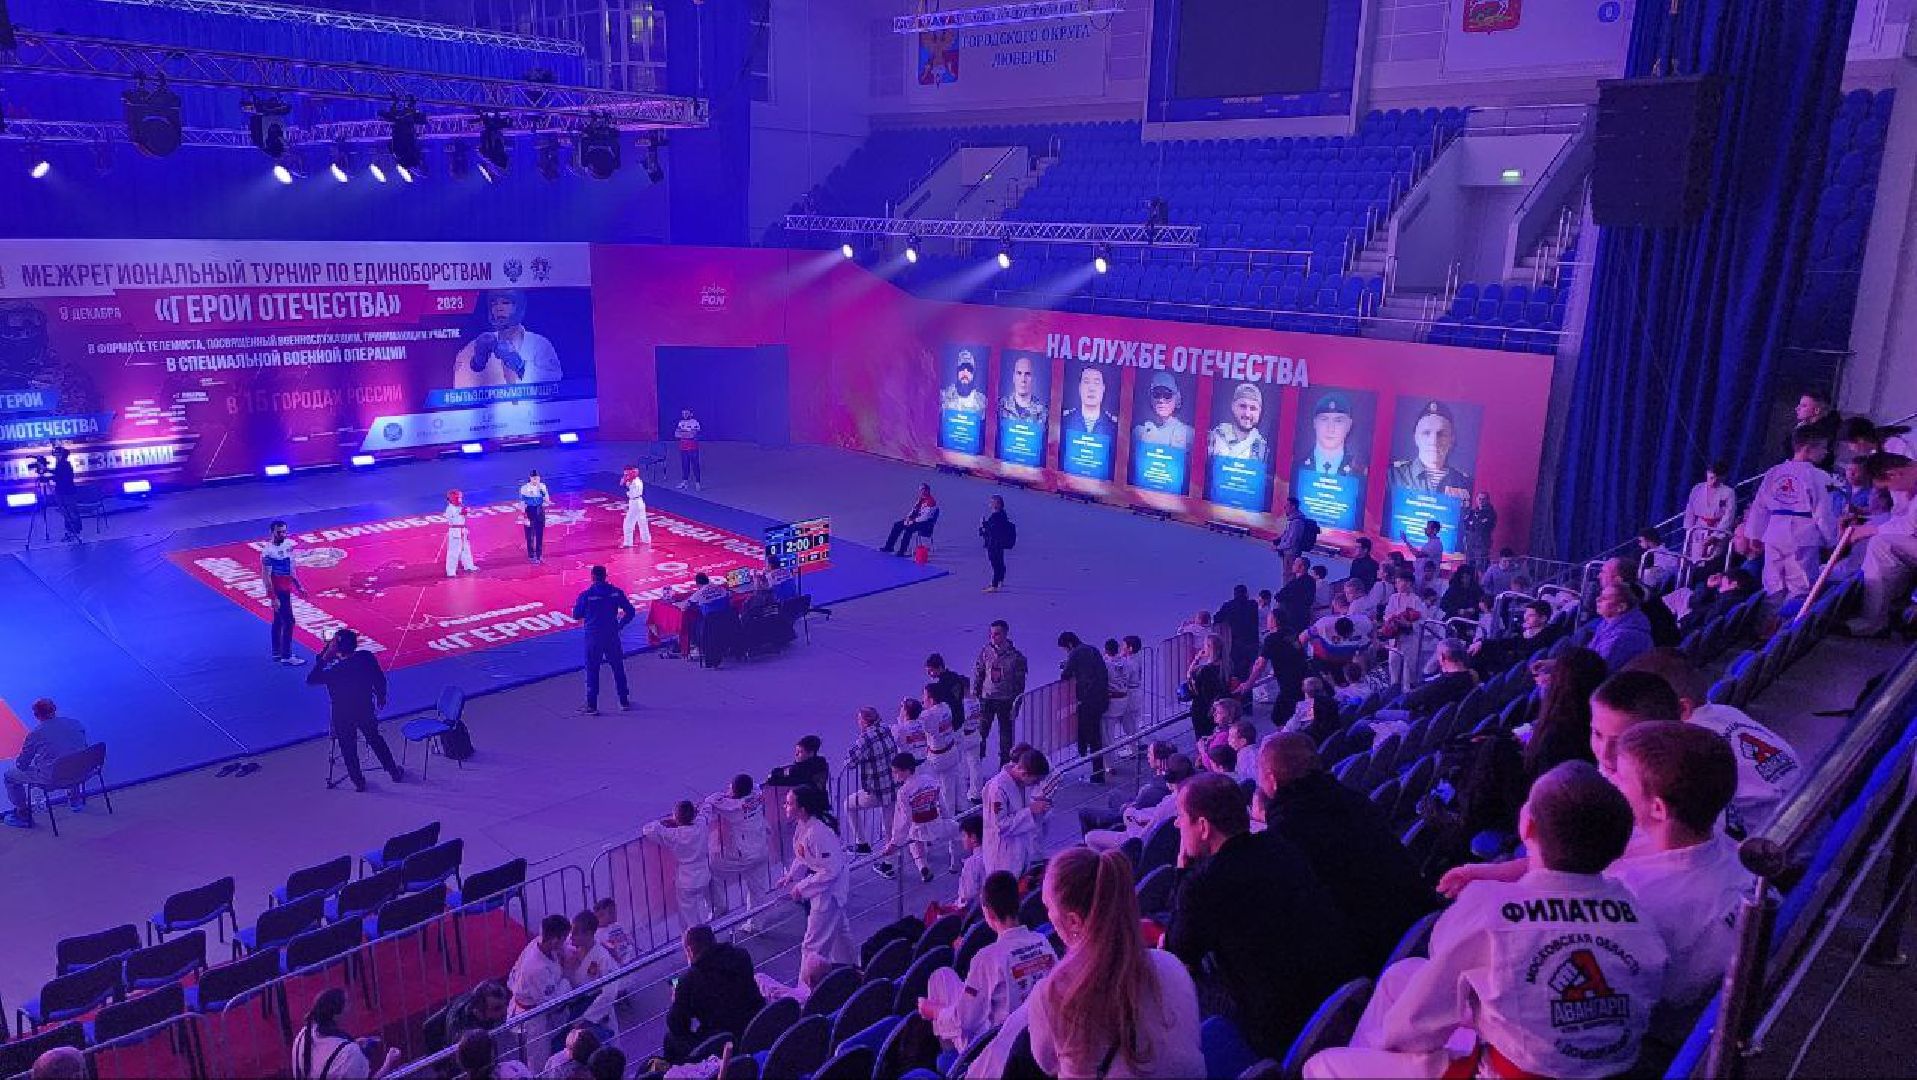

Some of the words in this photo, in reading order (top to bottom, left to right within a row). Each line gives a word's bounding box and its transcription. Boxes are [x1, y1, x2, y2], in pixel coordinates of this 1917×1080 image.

[962, 29, 1037, 49] ГОРОДСКОГО
[1041, 24, 1091, 42] ОКРУГА
[991, 50, 1057, 68] ЛЮБЕРЦЫ
[21, 259, 246, 287] МЕЖРЕГИОНАЛЬНЫЙ
[250, 262, 321, 284] ТУРНИР
[326, 262, 349, 283] ПО
[354, 261, 492, 284] ЕДИНОБОРСТВАМ
[72, 306, 122, 320] ДЕКАБРЯ
[155, 294, 252, 324] «ГЕРОИ
[258, 290, 401, 321] ОТЕЧЕСТВА»
[436, 296, 464, 311] 2023
[166, 357, 177, 372] В
[179, 349, 281, 372] СПЕЦИАЛЬНОЙ
[283, 346, 342, 366] ВОЕННОЙ
[344, 346, 407, 363] ОПЕРАЦИИ
[1047, 333, 1073, 360] НА
[1077, 337, 1167, 370] СЛУЖБЕ
[1171, 346, 1310, 388] ОТЕЧЕСТВА
[226, 396, 239, 414] В
[272, 388, 342, 412] ГОРОДАХ
[96, 451, 118, 470] ЗА
[786, 537, 810, 553] 2:00
[1502, 898, 1639, 922] ФИЛАТОВ
[1526, 933, 1593, 984] МОСКОВСКАЯ
